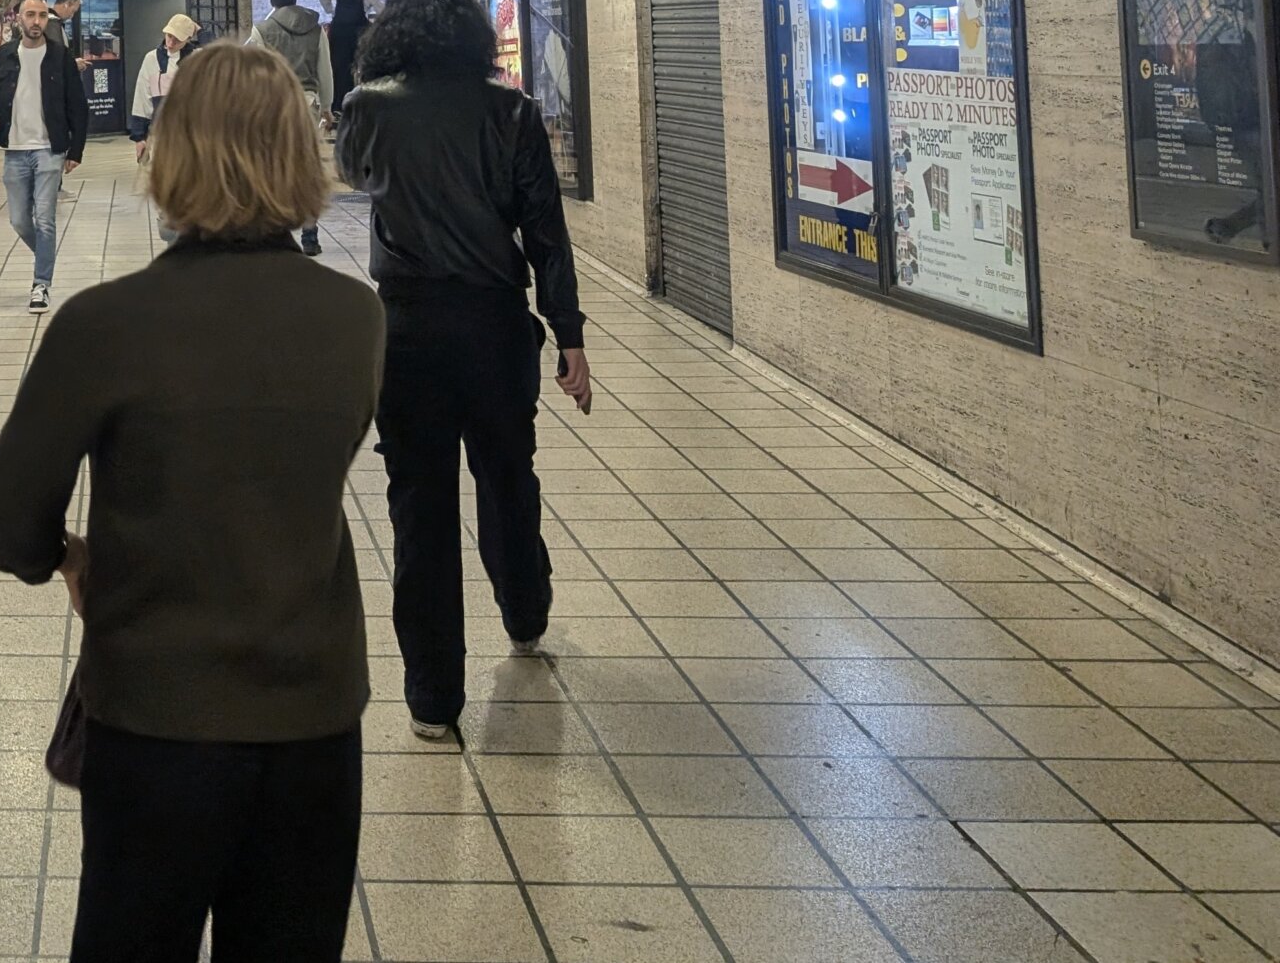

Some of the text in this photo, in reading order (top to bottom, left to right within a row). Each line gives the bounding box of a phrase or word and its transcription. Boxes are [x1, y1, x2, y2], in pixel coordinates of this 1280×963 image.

[1153, 64, 1176, 75] Exit 4
[888, 71, 951, 96] PASSPORT
[955, 76, 1016, 103] PHOTOS
[800, 96, 808, 144] KEYS
[890, 100, 1016, 127] READY IN 2 MINUTES
[781, 53, 793, 199] PHOTOS
[918, 128, 952, 144] PASSPORT
[973, 131, 1008, 147] PASSPORT
[917, 142, 962, 160] PHOTO SPECIALIST
[972, 145, 1017, 162] PHOTO SPECIALIST
[971, 164, 1015, 179] Save Money On Your
[971, 176, 991, 188] Passport
[799, 214, 877, 263] ENTRANCE THIS
[985, 265, 1015, 282] See in-store
